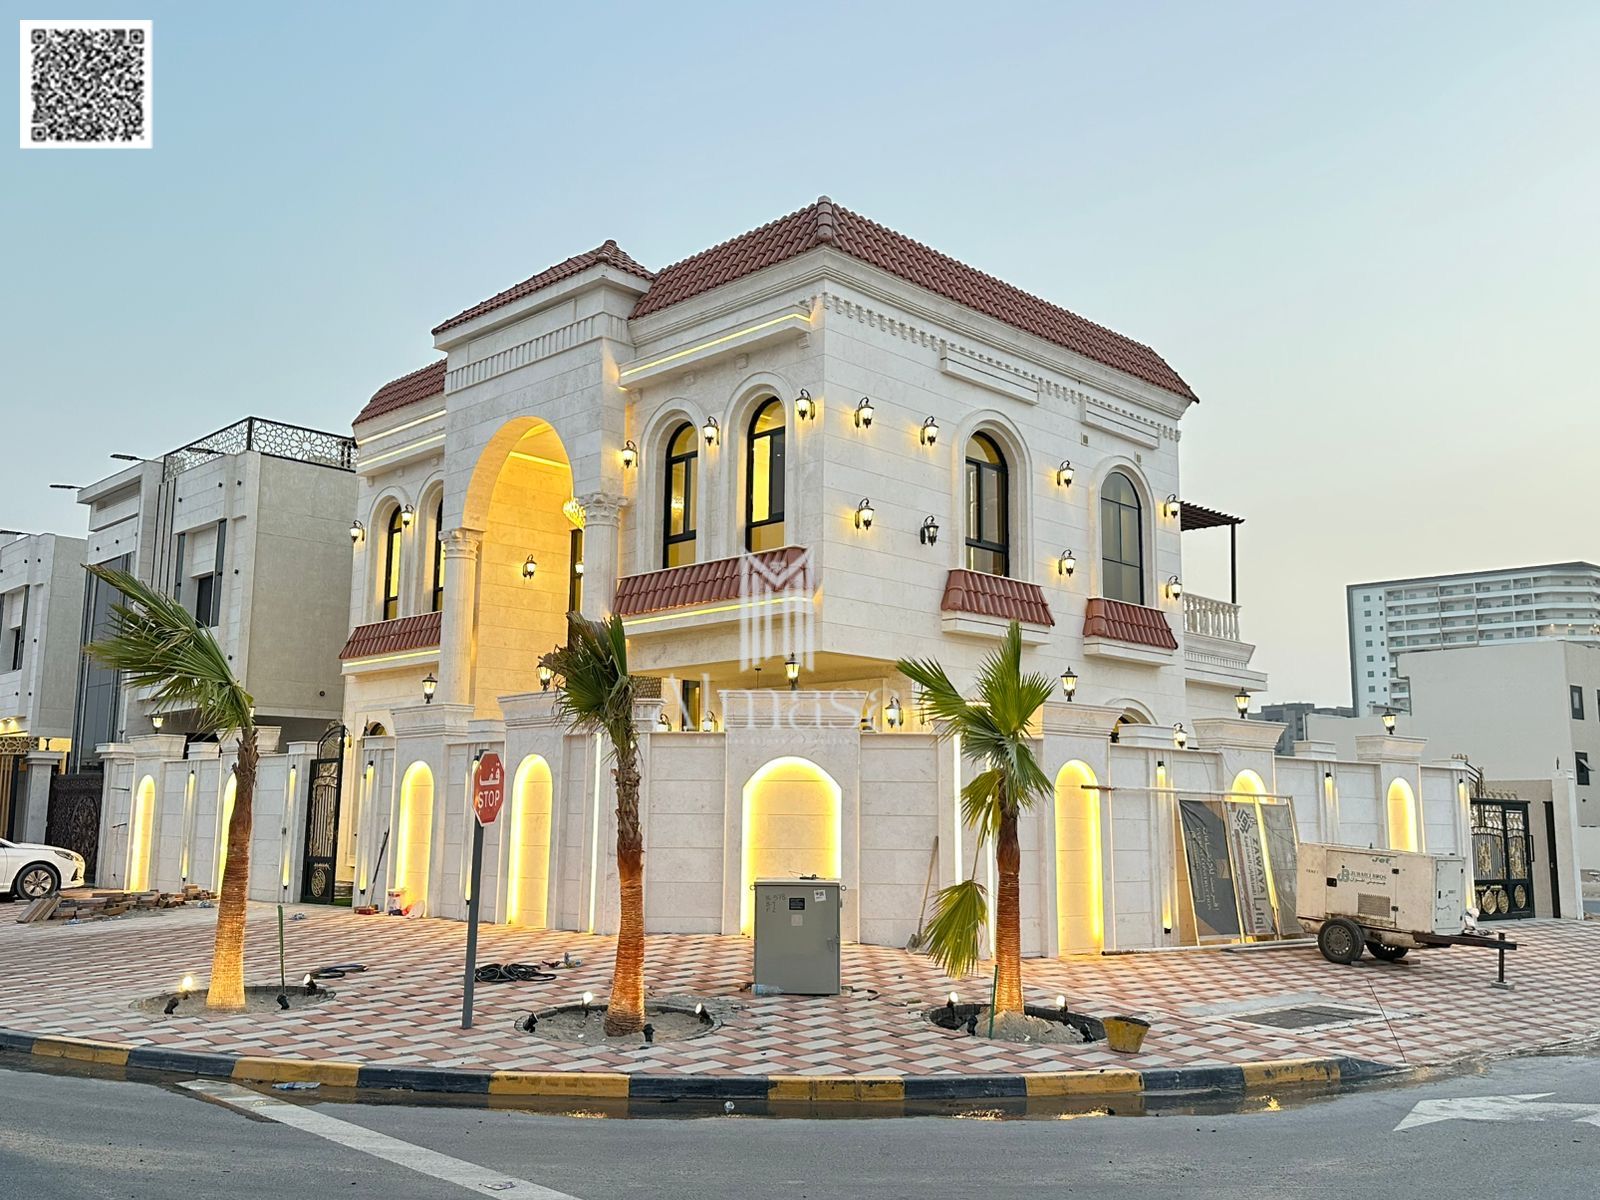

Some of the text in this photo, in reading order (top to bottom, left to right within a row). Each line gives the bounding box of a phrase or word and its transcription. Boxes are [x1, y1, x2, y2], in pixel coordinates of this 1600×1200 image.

[480, 762, 500, 786] قف
[478, 790, 500, 808] STOP
[1252, 838, 1265, 893] ZAWAYA
